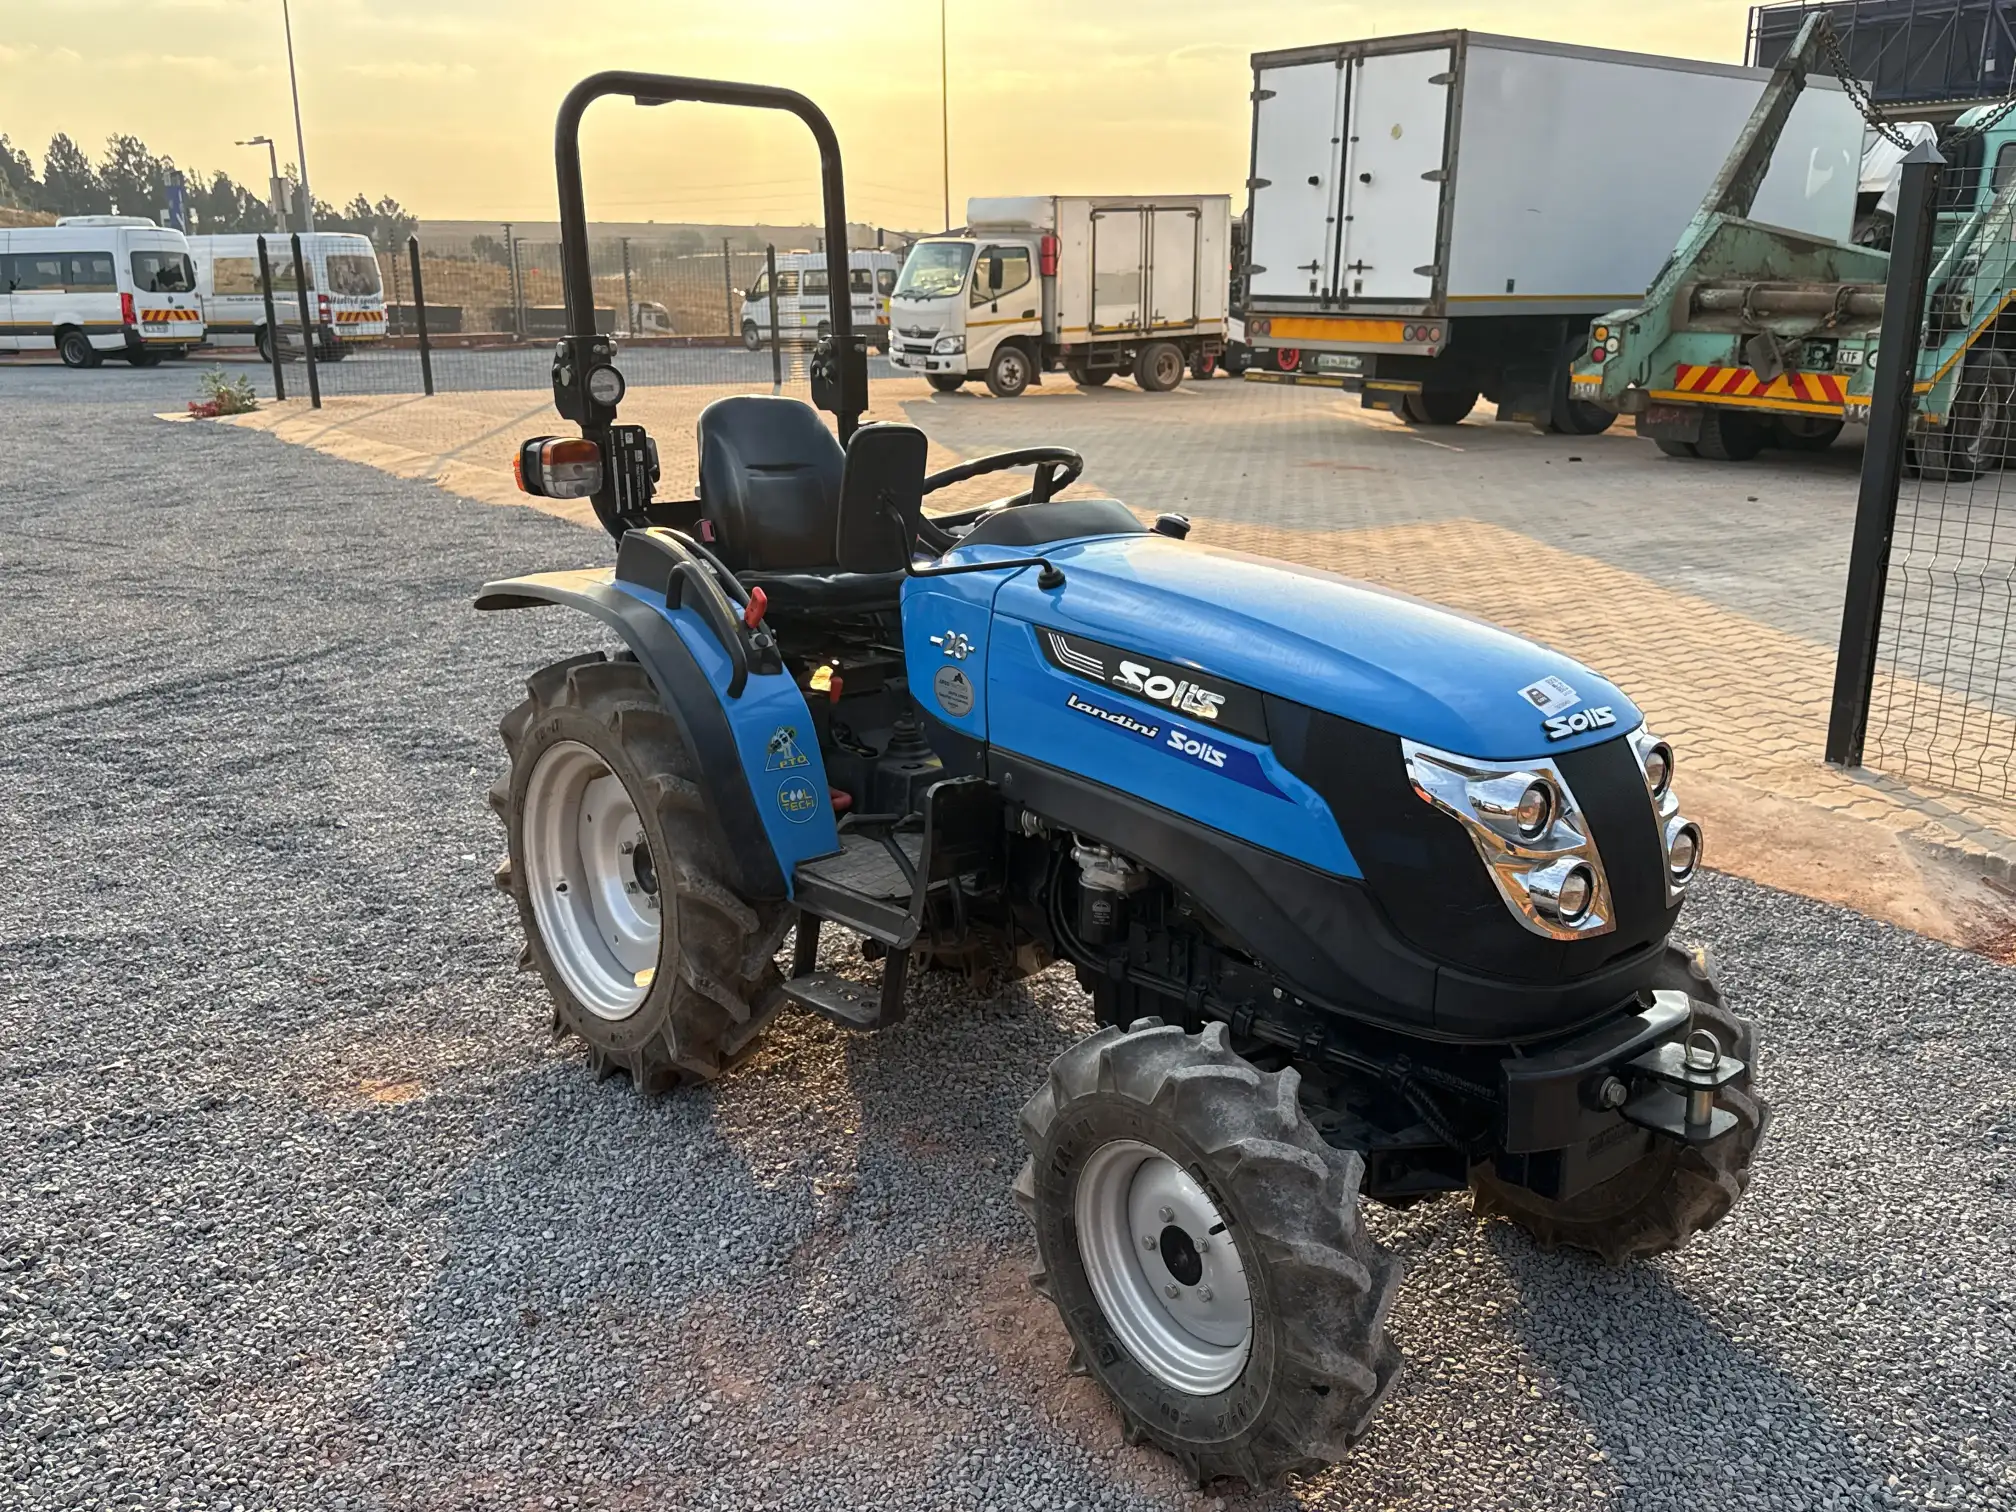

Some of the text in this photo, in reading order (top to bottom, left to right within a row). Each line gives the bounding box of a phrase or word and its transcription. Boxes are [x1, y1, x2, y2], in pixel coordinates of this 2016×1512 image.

[1840, 351, 1858, 364] KTF
[1066, 694, 1159, 739] Landini
[779, 755, 807, 768] PTO
[782, 800, 814, 812] TECH
